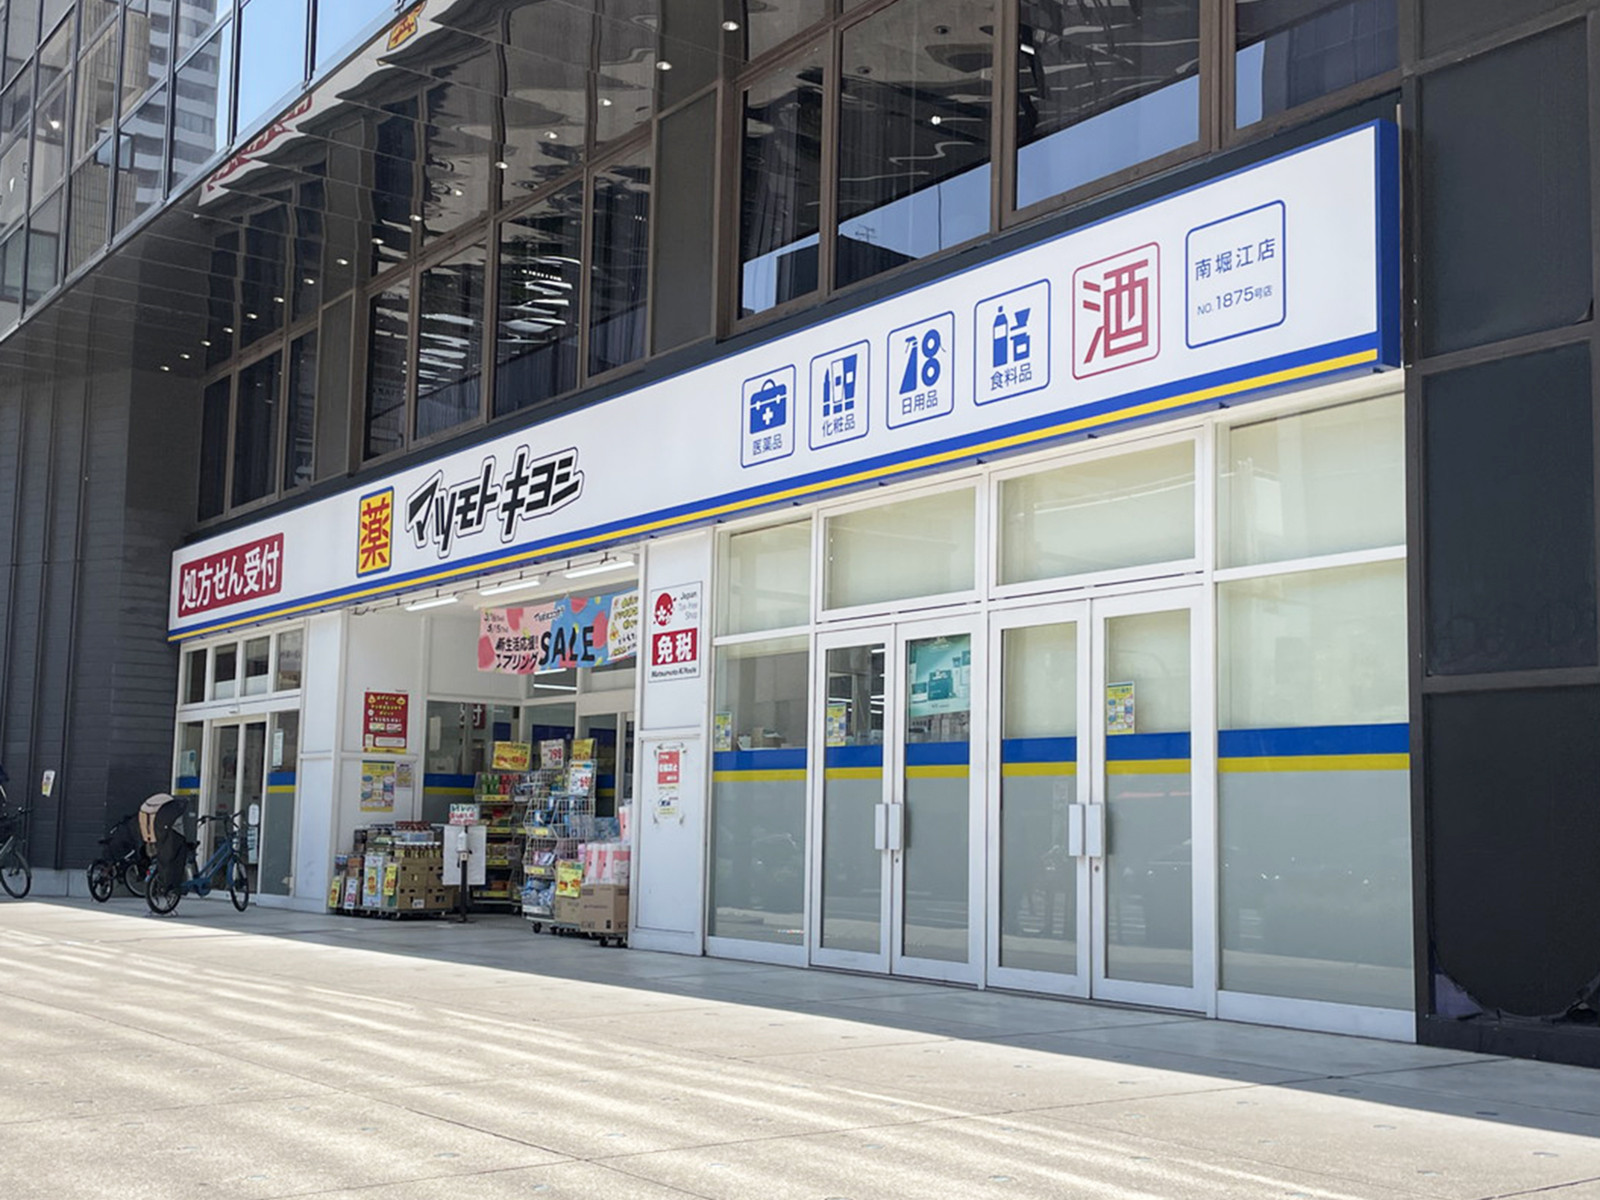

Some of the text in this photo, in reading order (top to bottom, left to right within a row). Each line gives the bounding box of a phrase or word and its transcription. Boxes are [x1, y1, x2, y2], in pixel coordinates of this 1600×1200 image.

[1194, 238, 1276, 281] 南堀江店
[1083, 258, 1149, 366] 酒
[990, 362, 1032, 391] 食料品
[902, 389, 938, 415] 日用品
[752, 433, 783, 456] 医薬品
[822, 413, 856, 437] 化粧品
[407, 451, 582, 553] マツモトキヨシ
[360, 497, 390, 568] 薬
[181, 540, 280, 611] 処方せん受付
[539, 625, 595, 666] SALE
[657, 631, 692, 664] 免税
